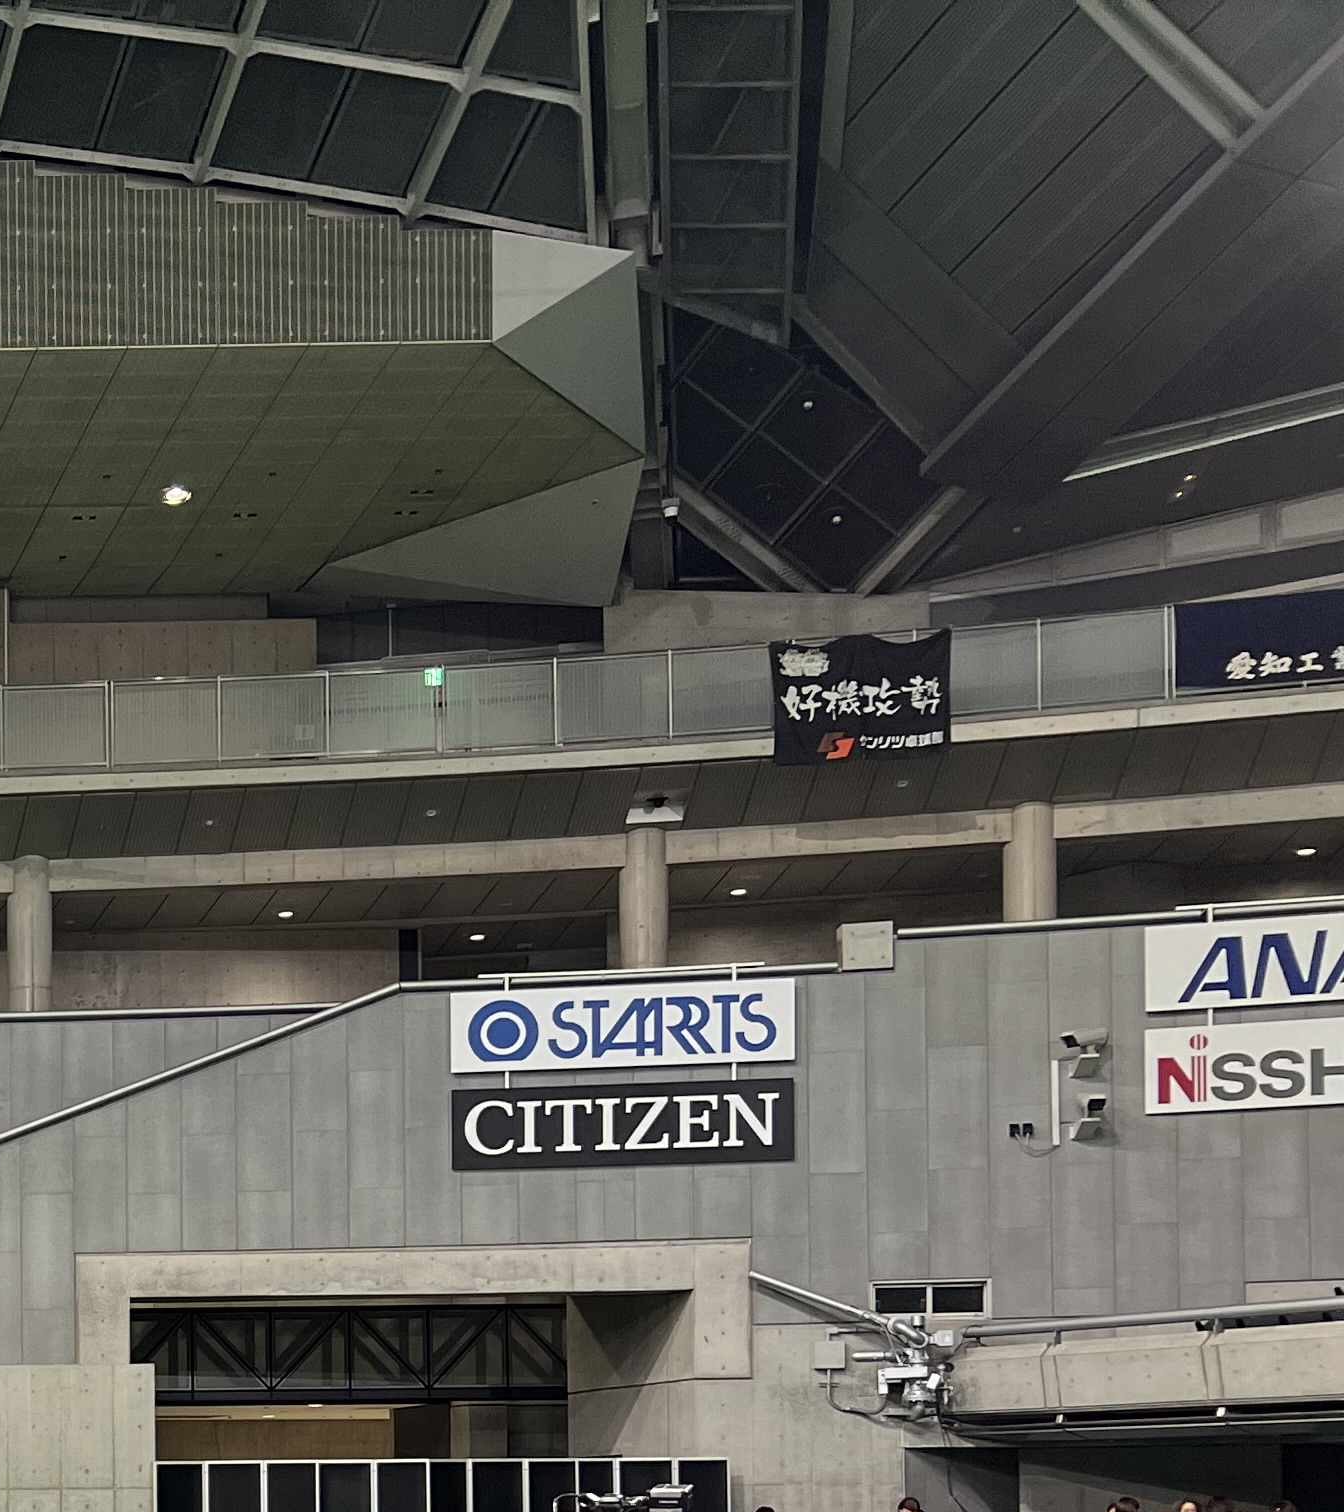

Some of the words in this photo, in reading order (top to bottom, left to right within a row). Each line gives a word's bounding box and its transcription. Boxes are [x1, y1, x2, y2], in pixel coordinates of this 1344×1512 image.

[780, 675, 944, 722] 好機攻勢
[464, 1092, 780, 1156] CITIZEN
